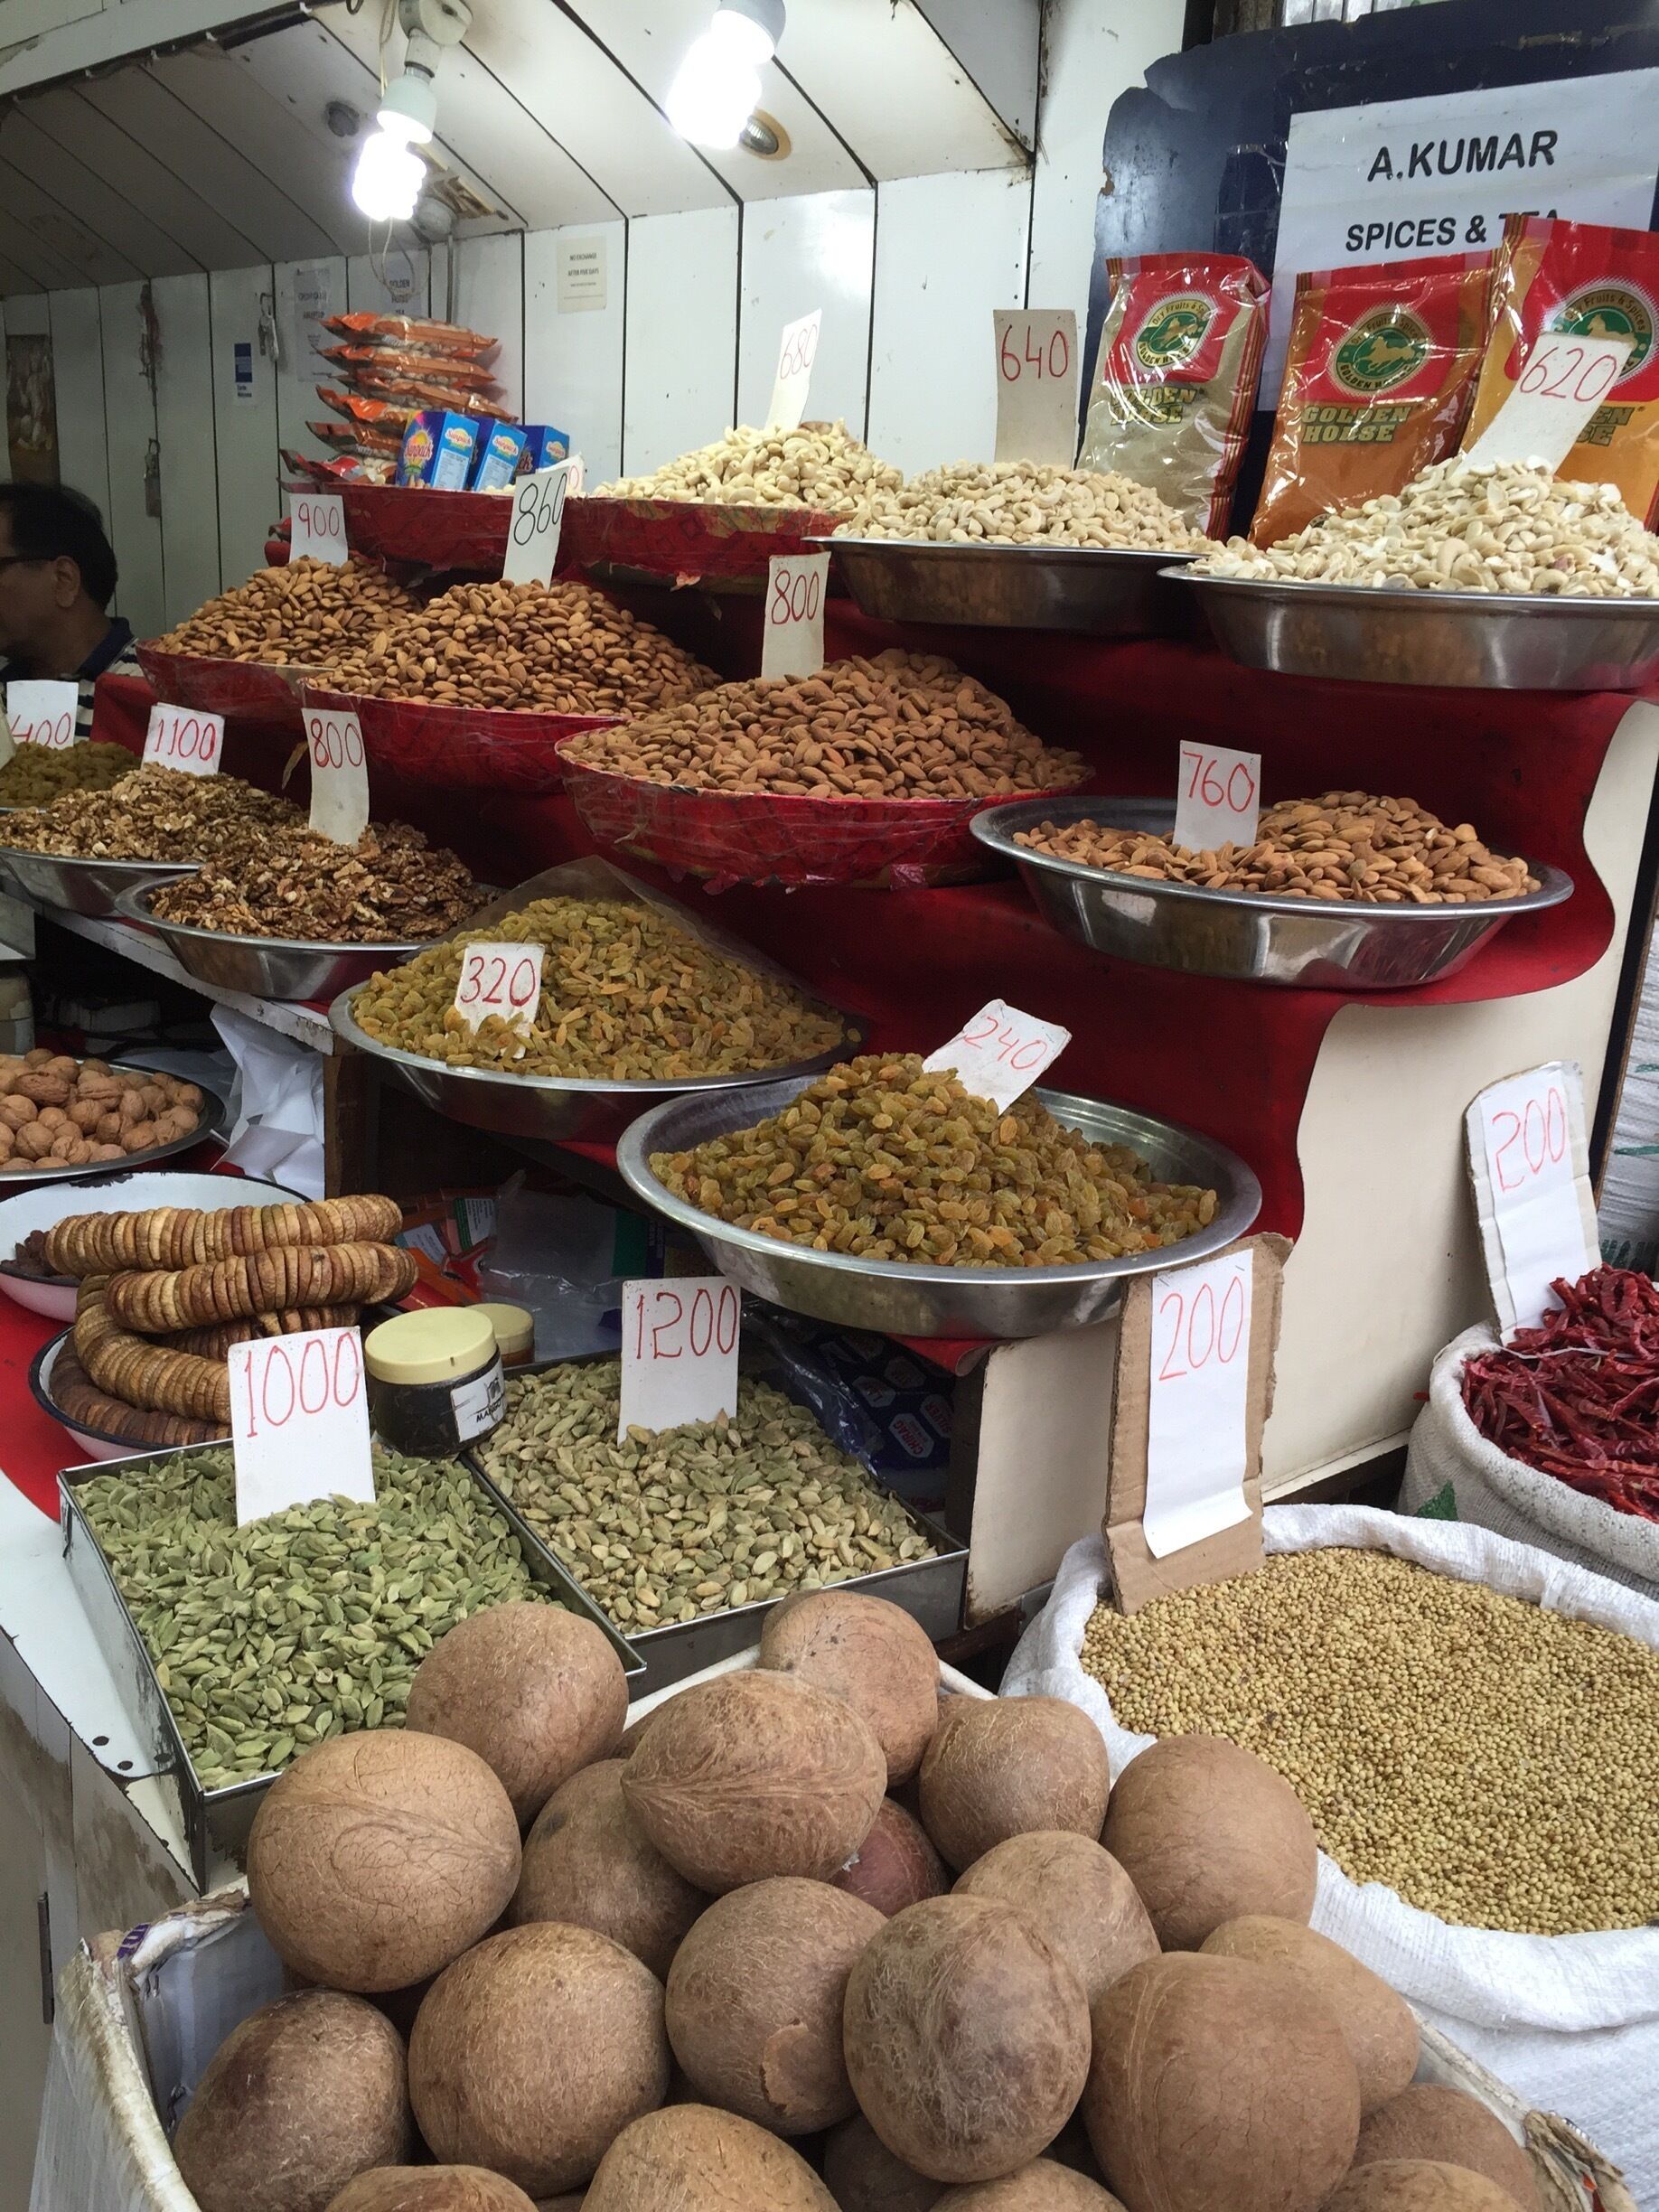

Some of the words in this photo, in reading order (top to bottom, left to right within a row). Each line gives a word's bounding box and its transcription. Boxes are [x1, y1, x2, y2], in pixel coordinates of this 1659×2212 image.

[1367, 129, 1559, 183] A.KUMAR
[1345, 217, 1457, 252] SPICES
[1465, 214, 1487, 244] &
[1166, 302, 1190, 313] Fruits
[1584, 294, 1616, 309] Fruits
[1625, 301, 1647, 332] Spices
[780, 323, 818, 380] 680
[1001, 324, 1068, 381] 640
[1340, 364, 1372, 389] GOLDEN
[1520, 346, 1617, 402] 620
[1300, 406, 1413, 424] GOLDEN
[298, 502, 340, 538] 900
[513, 473, 567, 546] 860
[772, 569, 820, 624] 800
[155, 718, 216, 761] 1100
[311, 717, 363, 769] 800
[1183, 750, 1255, 812] 760
[460, 956, 536, 1007] 320
[963, 1016, 1048, 1070] 240
[1492, 1087, 1566, 1193] 200
[636, 1285, 738, 1359] 1200
[1158, 1276, 1244, 1381] 200
[244, 1331, 361, 1438] 1000
[894, 1419, 924, 1456] CHIRAG
